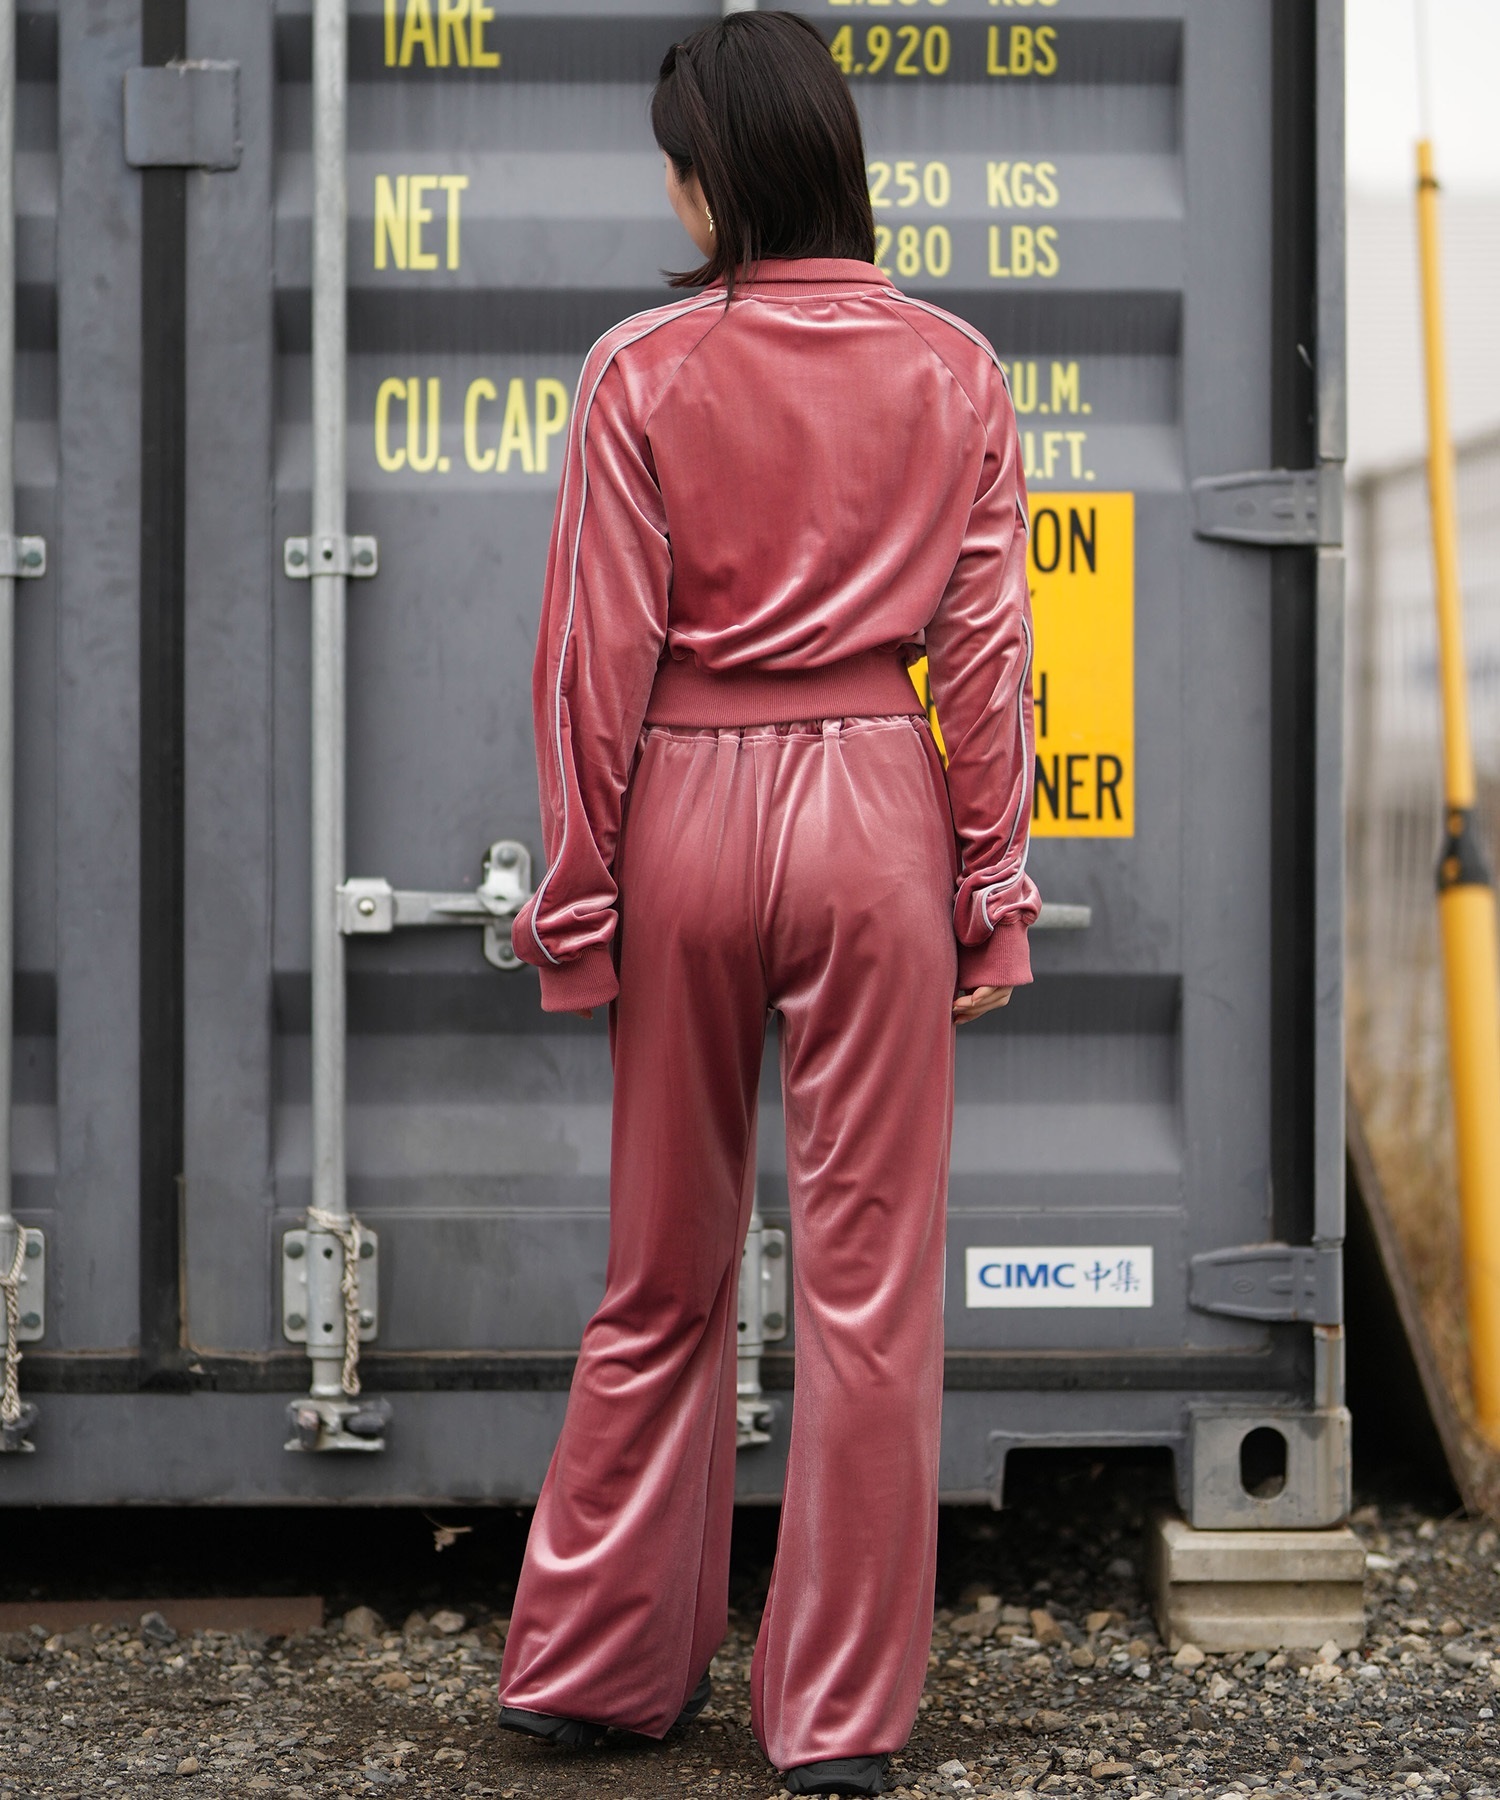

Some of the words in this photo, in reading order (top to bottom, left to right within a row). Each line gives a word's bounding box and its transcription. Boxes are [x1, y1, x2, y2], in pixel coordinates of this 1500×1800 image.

[986, 24, 1058, 76] LBS
[986, 160, 1060, 209] KGS
[374, 174, 469, 271] NET
[988, 224, 1060, 279] LBS
[1000, 360, 1093, 414] U.M.
[374, 376, 450, 473] CU.
[463, 376, 570, 473] CAP
[977, 1263, 1076, 1289] CIMC
